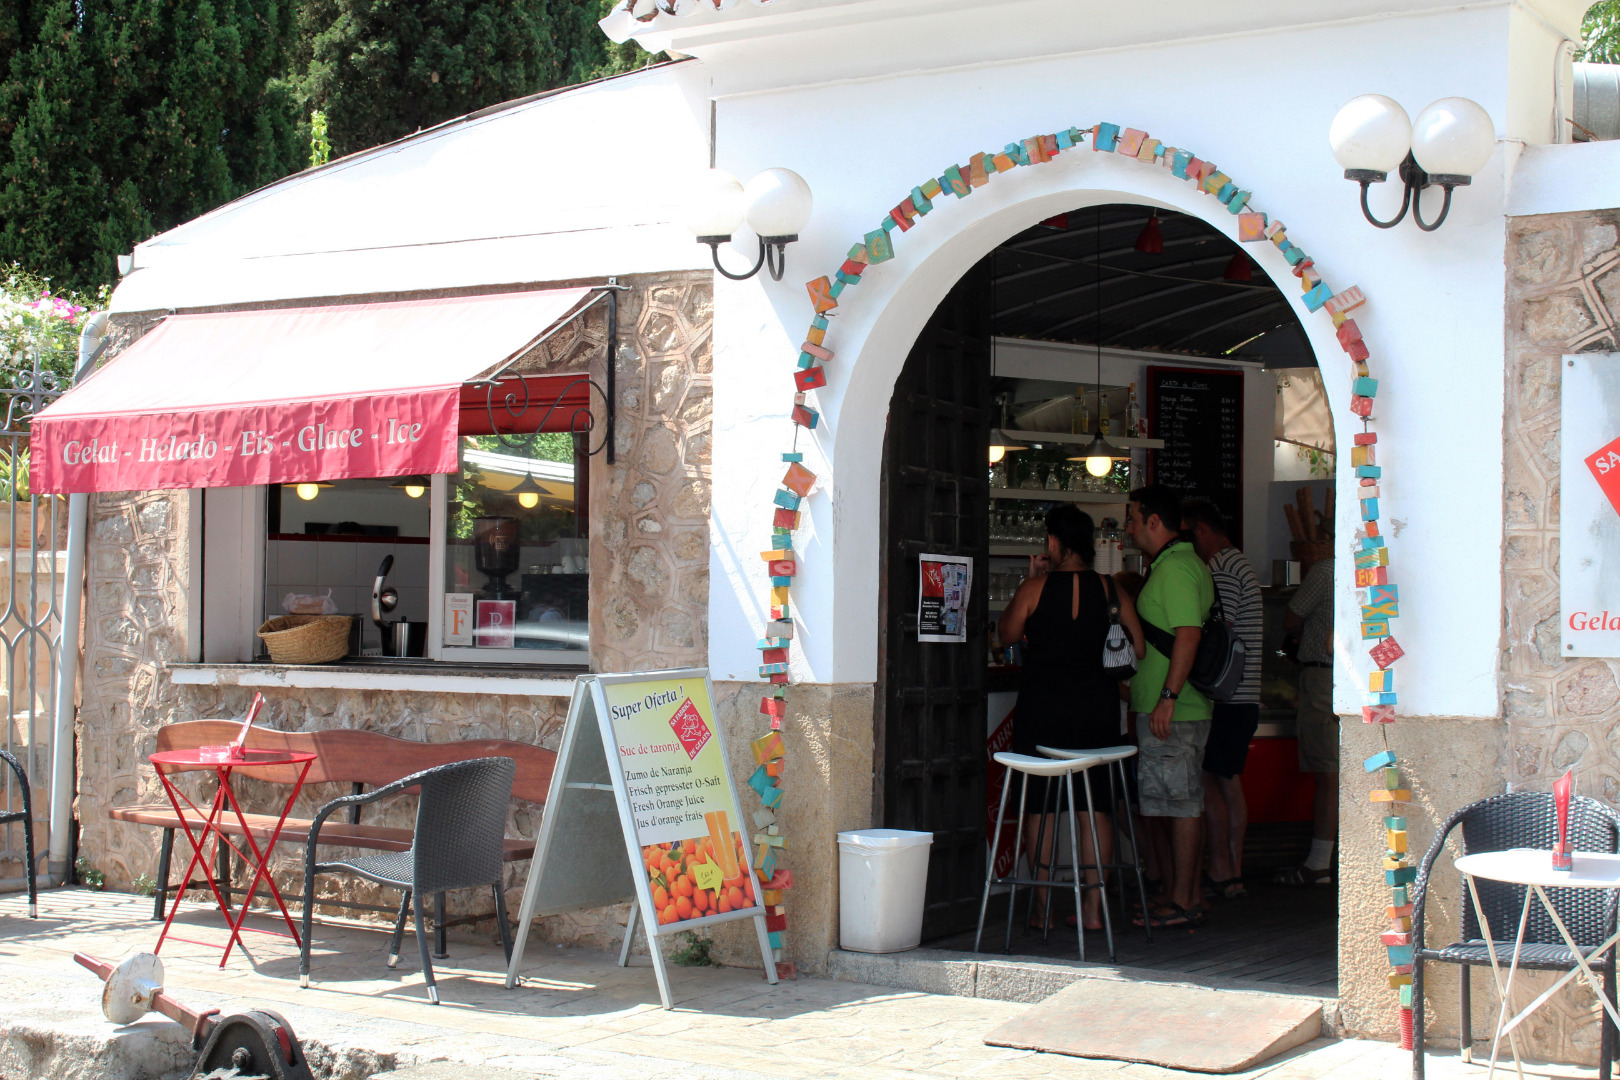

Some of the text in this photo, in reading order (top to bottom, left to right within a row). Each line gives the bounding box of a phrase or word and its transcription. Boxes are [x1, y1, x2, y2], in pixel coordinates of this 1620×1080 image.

[63, 438, 118, 465] Gelat
[138, 433, 218, 463] Helado
[240, 430, 275, 457] Eis
[297, 423, 363, 452] Glace
[386, 418, 422, 445] Ice
[1595, 450, 1620, 475] SA
[452, 609, 468, 635] F
[1569, 610, 1620, 631] Gela
[611, 701, 642, 720] Super
[644, 691, 678, 712] Oferta
[619, 740, 681, 757] Suc de taronja
[625, 764, 693, 781] Zumo de Naranja
[628, 775, 721, 797] Frisch gepresster O-Saft
[632, 794, 705, 813] Fresh Orange Juice
[636, 810, 703, 830] Jus d'orange frais
[997, 847, 1013, 874] DE
